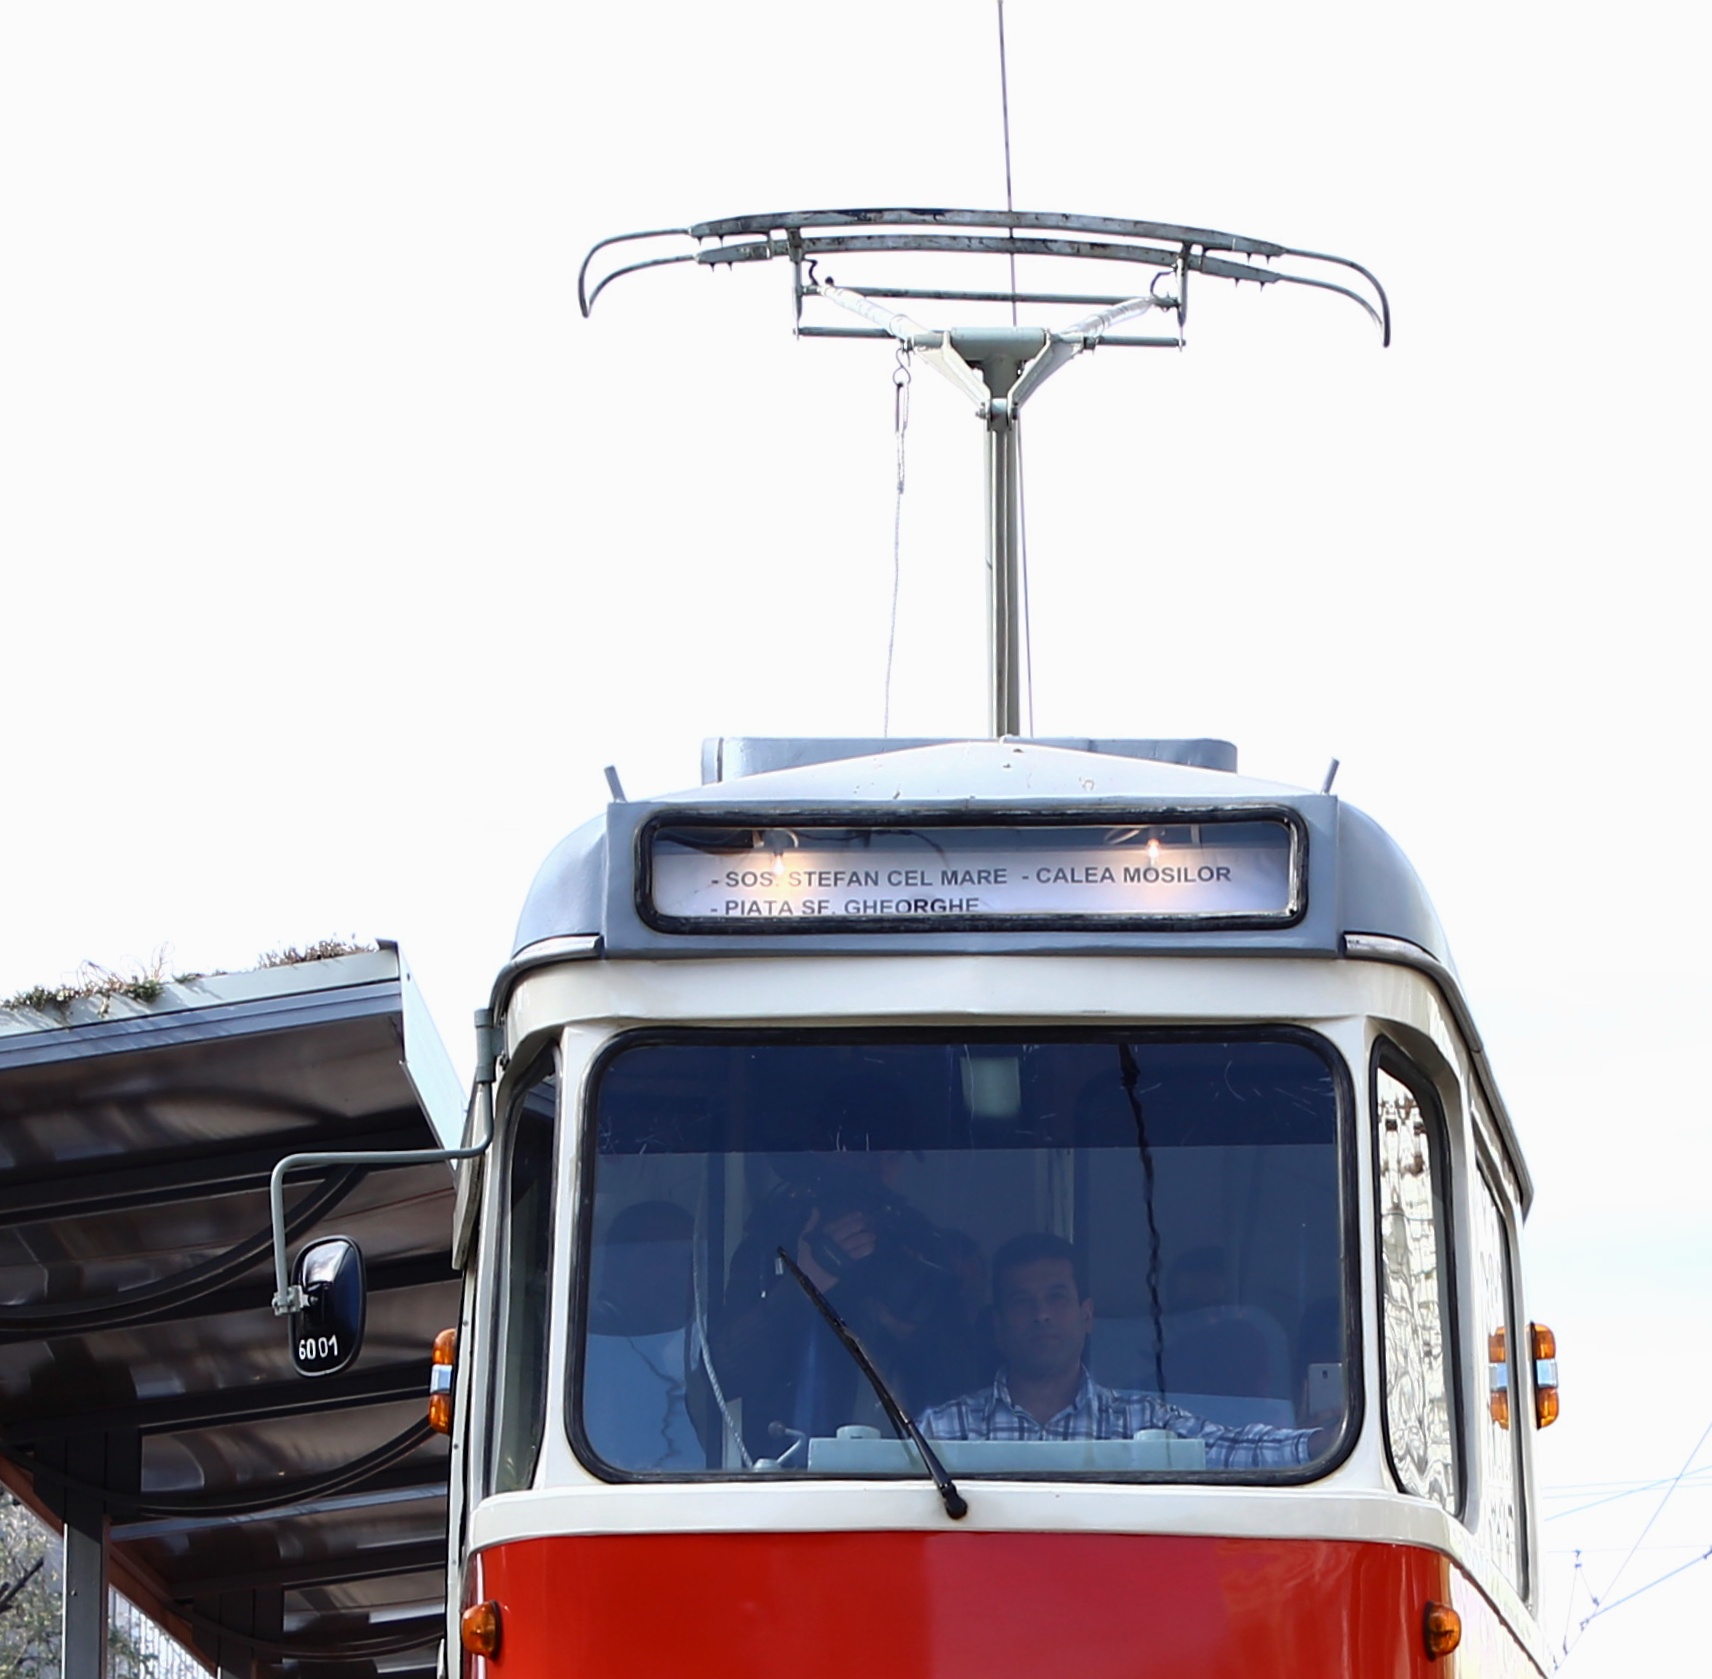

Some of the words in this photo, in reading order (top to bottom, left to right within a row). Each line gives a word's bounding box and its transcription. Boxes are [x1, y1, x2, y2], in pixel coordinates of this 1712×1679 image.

[788, 870, 880, 888] STEFAN
[886, 870, 934, 887] CEL
[940, 868, 1008, 886] MARE
[1035, 867, 1116, 884] CALEA
[1122, 866, 1232, 884] MOSILOR
[724, 899, 794, 916] PIATA
[843, 897, 980, 915] GHEORGHE
[299, 1334, 338, 1360] 6001
